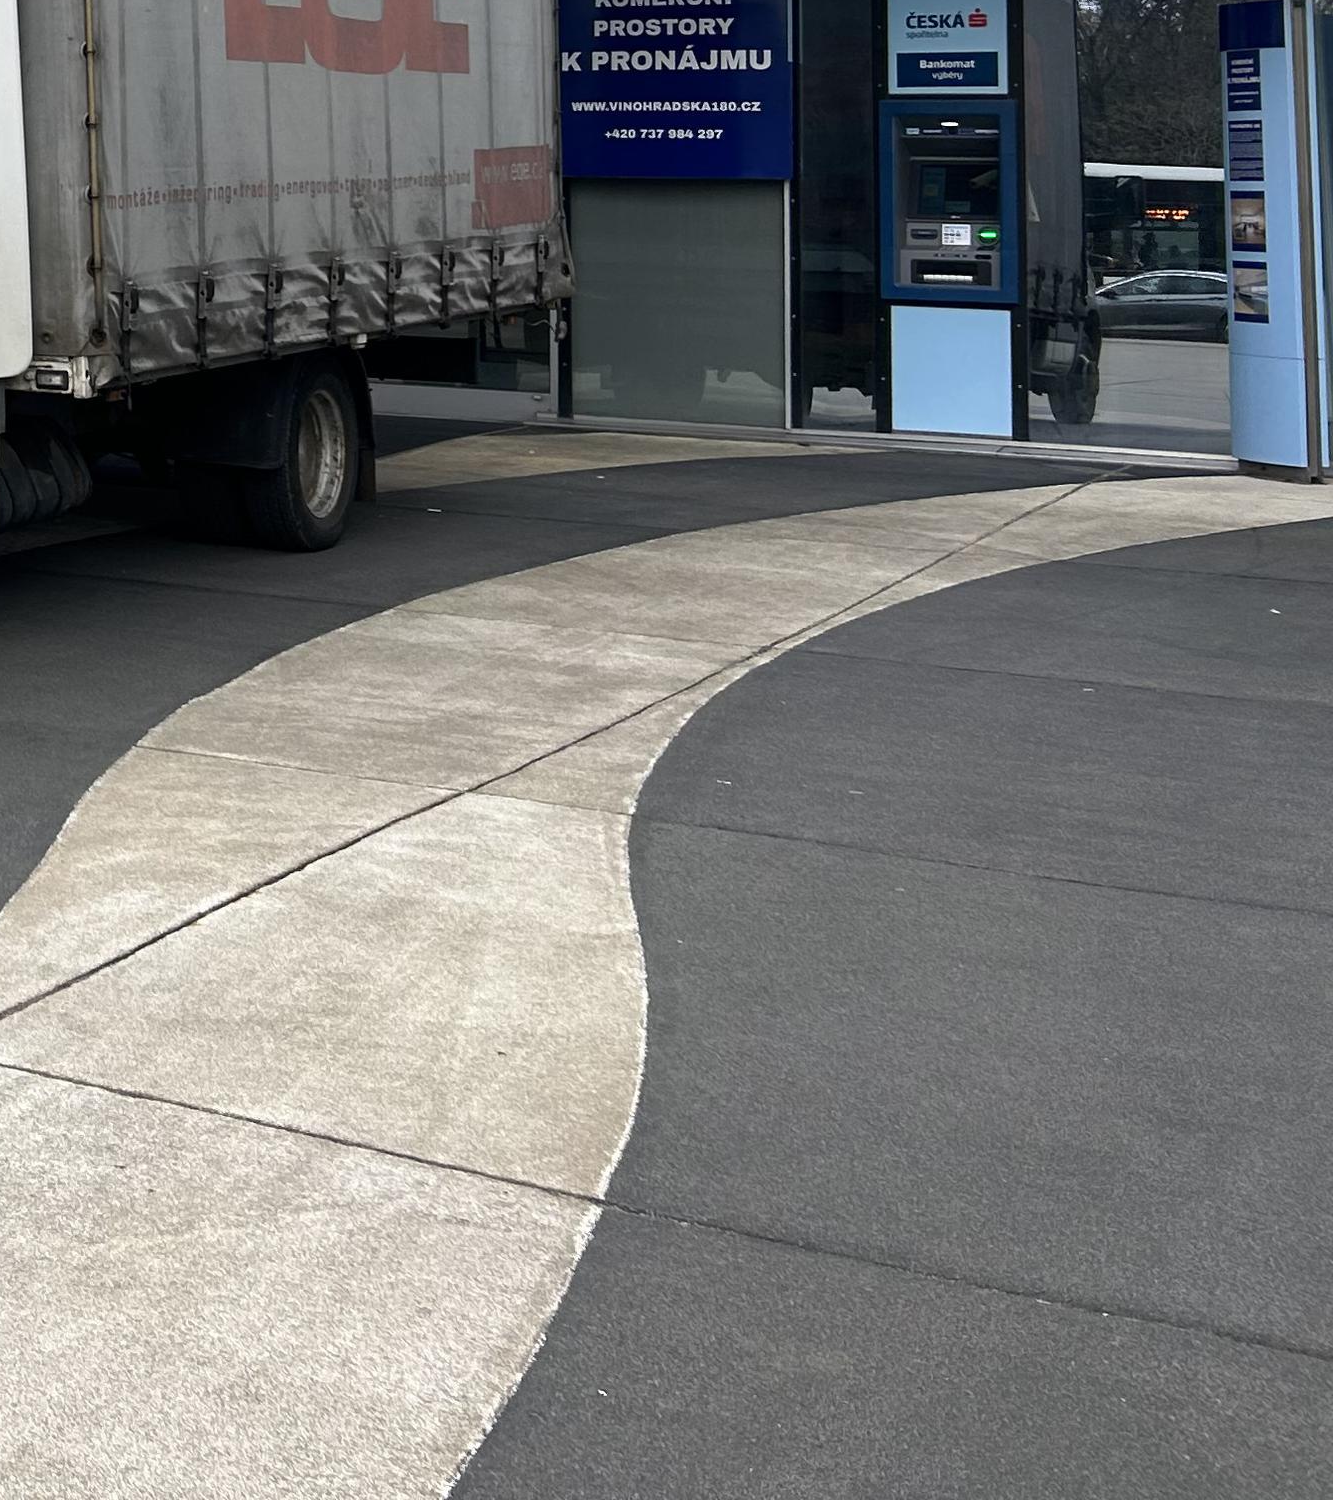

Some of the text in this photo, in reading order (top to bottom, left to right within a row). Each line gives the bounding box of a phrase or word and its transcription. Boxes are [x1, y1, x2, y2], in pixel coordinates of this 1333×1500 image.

[594, 17, 735, 37] PROSTORY
[905, 11, 965, 29] ČESKÁ
[561, 44, 772, 72] K PRONÁJMU
[919, 59, 976, 69] Bankomat
[571, 101, 762, 112] WWW.VINOHRADSKA180.CZ
[604, 129, 724, 140] +420 737 984 297
